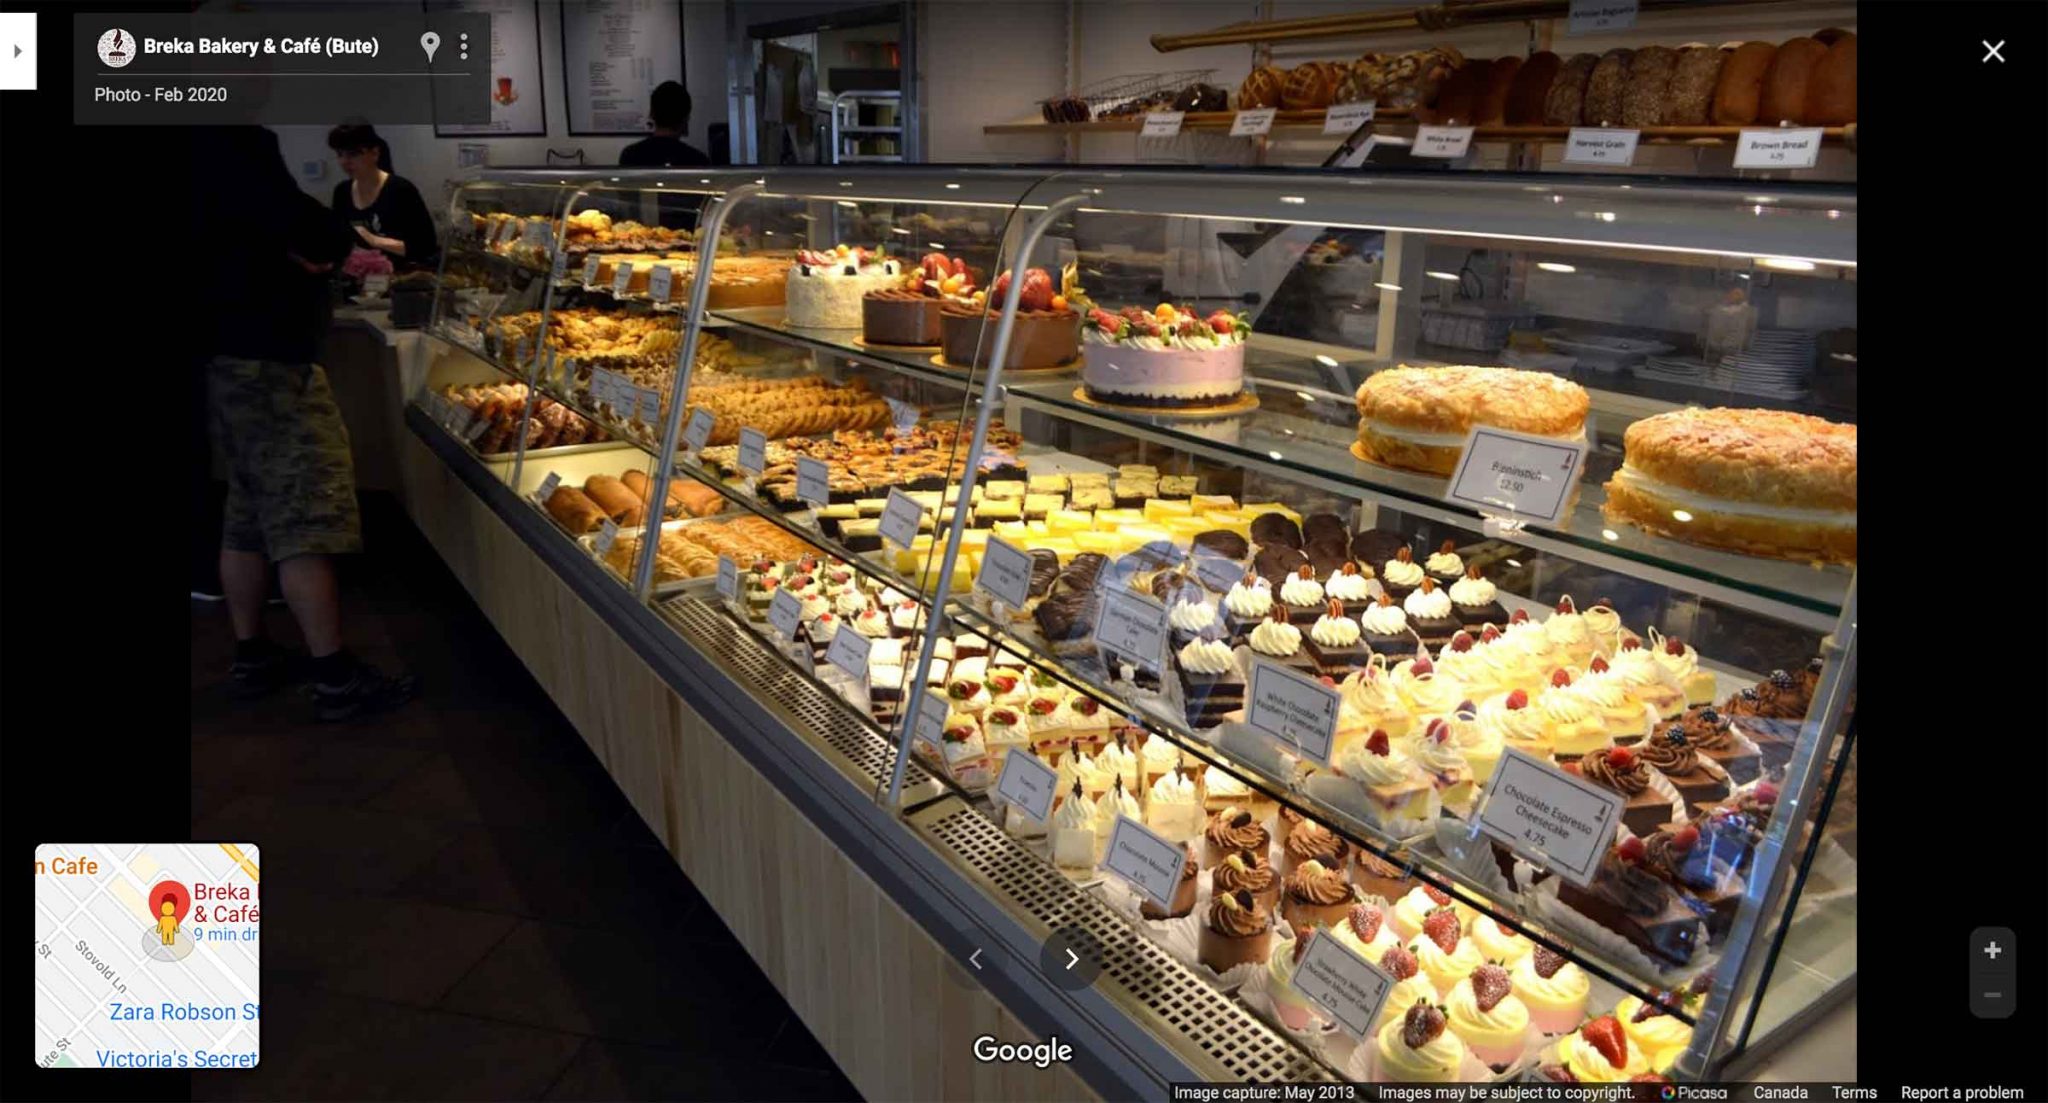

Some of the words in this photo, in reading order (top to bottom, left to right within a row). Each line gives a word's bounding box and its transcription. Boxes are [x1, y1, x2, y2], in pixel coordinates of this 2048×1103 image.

[1750, 140, 1780, 150] Brown
[1782, 140, 1809, 150] Bread
[1267, 692, 1286, 706] White
[1288, 701, 1319, 722] Chocolate
[1504, 784, 1551, 814] Chocolate
[1551, 807, 1593, 836] Espresso
[1515, 804, 1570, 840] Cheesecake
[1523, 828, 1546, 847] 4.75
[1119, 840, 1149, 864] Chocolate
[1304, 962, 1332, 986] Chocolate
